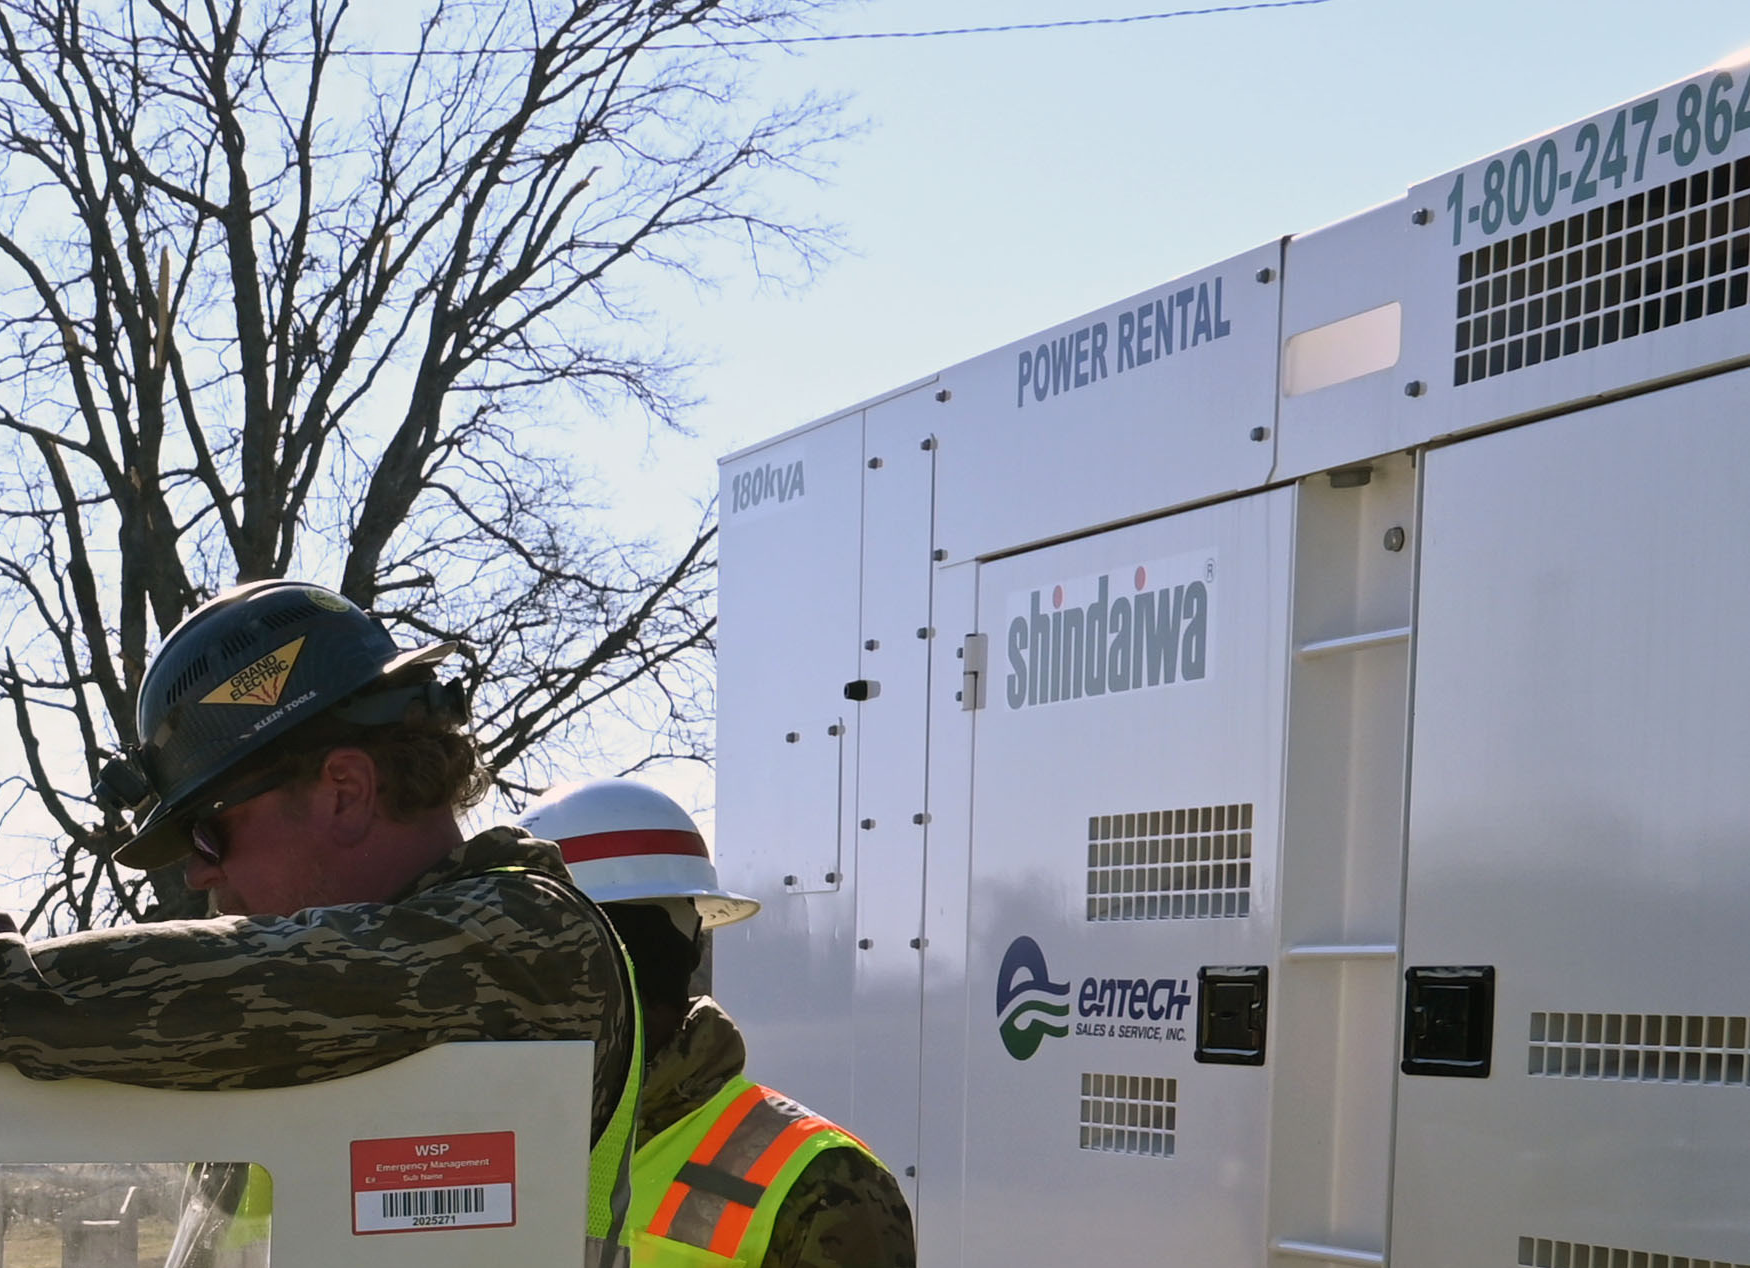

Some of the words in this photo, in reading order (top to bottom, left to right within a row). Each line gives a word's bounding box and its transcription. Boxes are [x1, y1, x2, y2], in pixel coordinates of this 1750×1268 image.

[1017, 322, 1108, 408] POWER
[1117, 276, 1231, 374] RENTAL
[732, 460, 805, 514] 180kVA
[1006, 566, 1208, 711] shindaiwa
[230, 654, 277, 688] GRAND
[230, 660, 289, 701] ELECTRIC
[254, 708, 284, 731] KLEIN
[285, 690, 317, 712] TOOLS
[1076, 1023, 1105, 1036] SALES
[1108, 1025, 1115, 1037] &
[1118, 1025, 1162, 1043] SERVICE,
[1166, 1028, 1186, 1041] INC.
[376, 1162, 428, 1174] Emergency
[430, 1158, 490, 1170] Management
[415, 1143, 450, 1157] WSP
[421, 1173, 443, 1181] Name
[412, 1215, 456, 1226] 2025271
